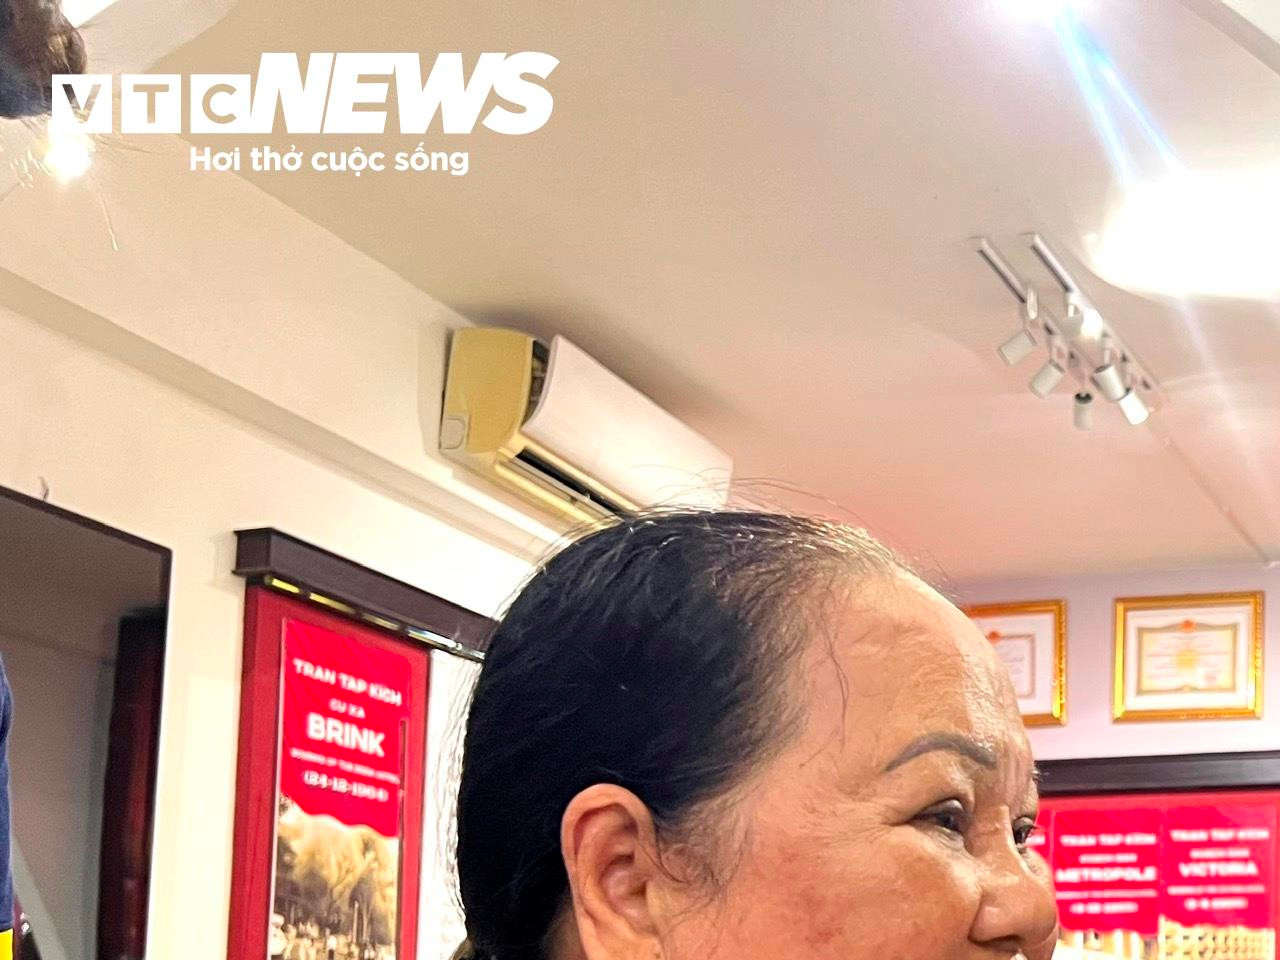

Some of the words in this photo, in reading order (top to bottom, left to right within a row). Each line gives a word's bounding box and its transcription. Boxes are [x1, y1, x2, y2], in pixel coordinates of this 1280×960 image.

[306, 711, 386, 758] BRINK
[1055, 865, 1157, 883] METROPOLE
[1178, 860, 1259, 878] VICTORIA
